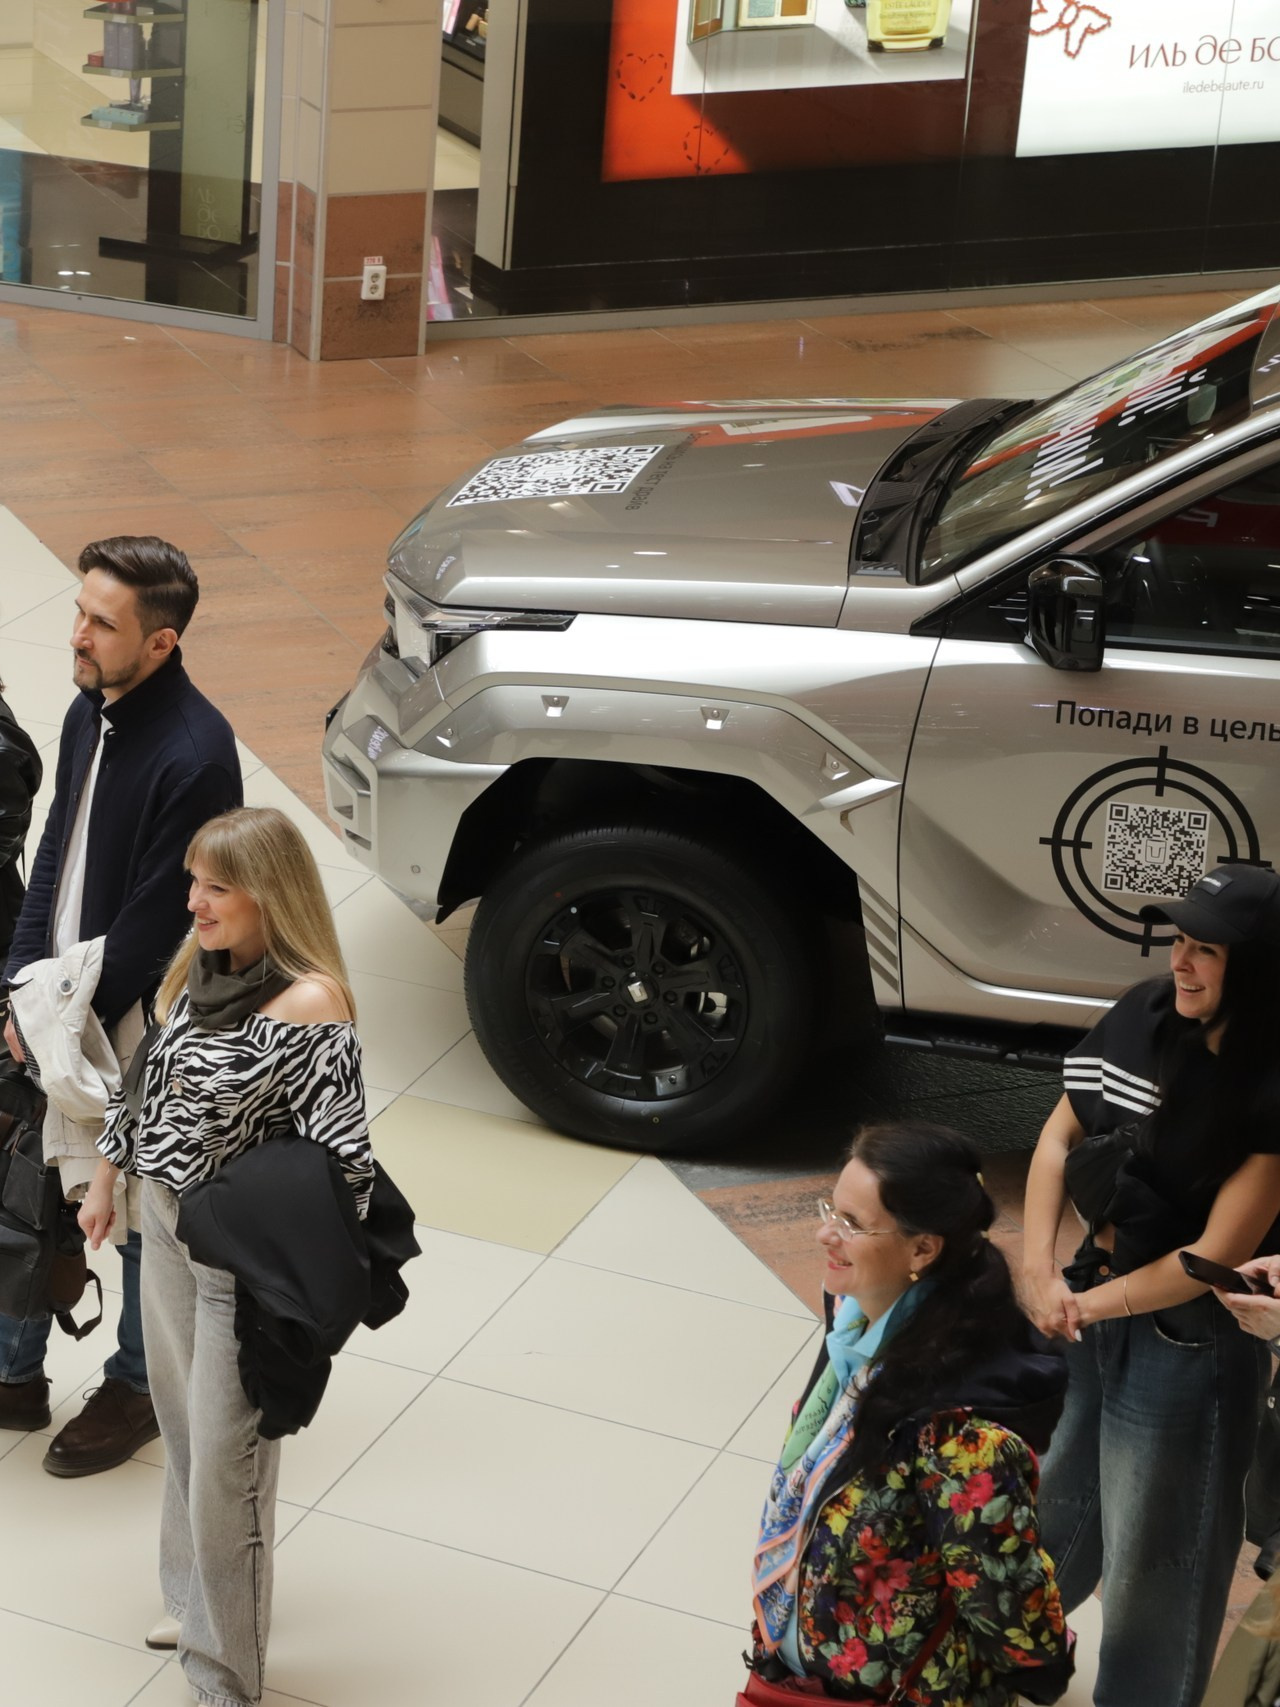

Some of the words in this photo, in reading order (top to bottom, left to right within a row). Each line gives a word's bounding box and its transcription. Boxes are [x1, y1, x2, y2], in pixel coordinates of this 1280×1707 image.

[1128, 42, 1187, 69] ИЛЬ
[1182, 79, 1265, 94] iledebeaute.ru
[1055, 699, 1172, 736] Попади
[1183, 715, 1199, 735] в
[1209, 717, 1280, 743] цель
